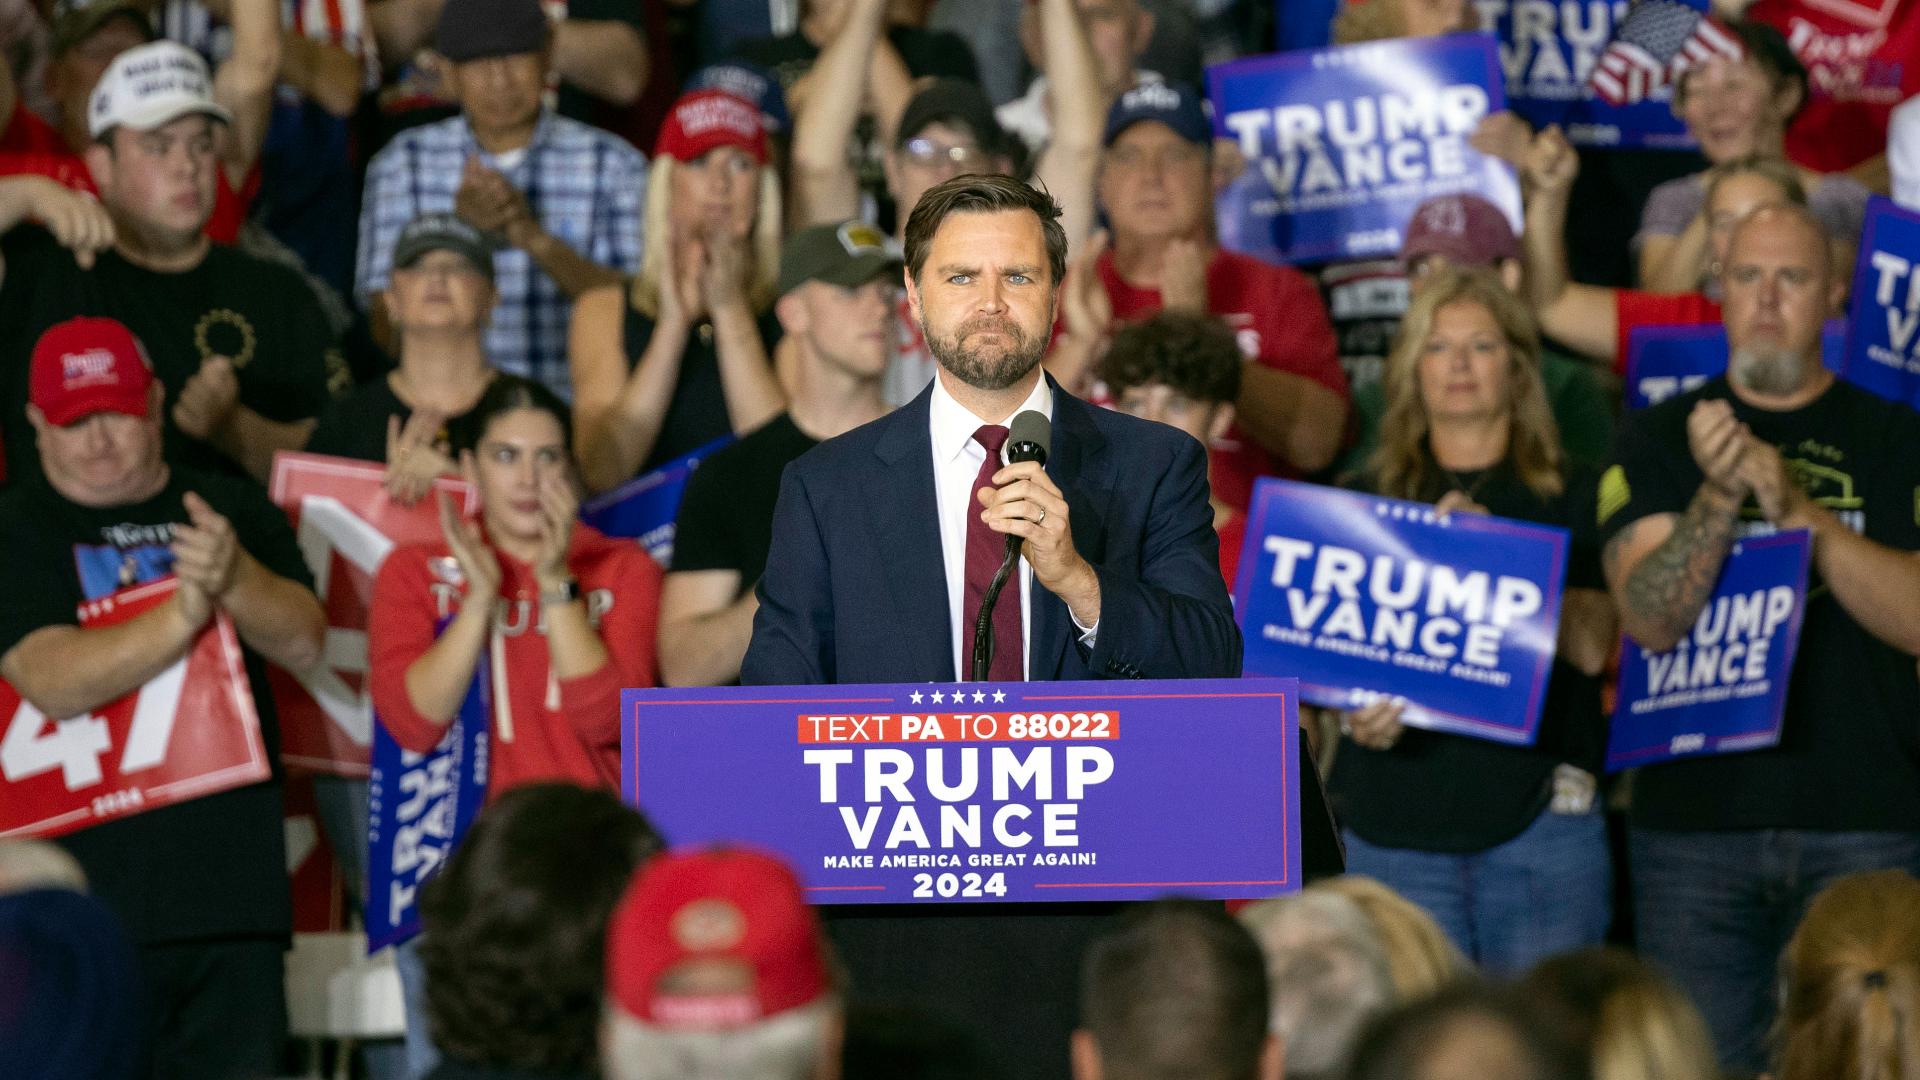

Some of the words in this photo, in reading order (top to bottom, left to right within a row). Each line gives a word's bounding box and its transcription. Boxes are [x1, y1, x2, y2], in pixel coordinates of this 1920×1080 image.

[1224, 84, 1489, 157] TRUMP
[1260, 134, 1467, 194] VANCE
[1264, 535, 1542, 626] TRUMP
[430, 582, 614, 637] TUP
[1286, 588, 1504, 668] VANCE
[1646, 638, 1770, 695] VANCE
[807, 716, 890, 741] TEXT
[901, 715, 944, 740] PA
[953, 714, 997, 739] TO
[1008, 713, 1110, 739] 88022
[803, 746, 1115, 803] TRUMP
[389, 749, 429, 926] TRU
[838, 803, 1079, 850] VANCE
[824, 855, 874, 868] MAKE
[880, 854, 961, 867] AMERICA
[968, 853, 1027, 867] GREAT
[1033, 852, 1097, 866] AGAIN!
[913, 872, 1007, 898] 2024
